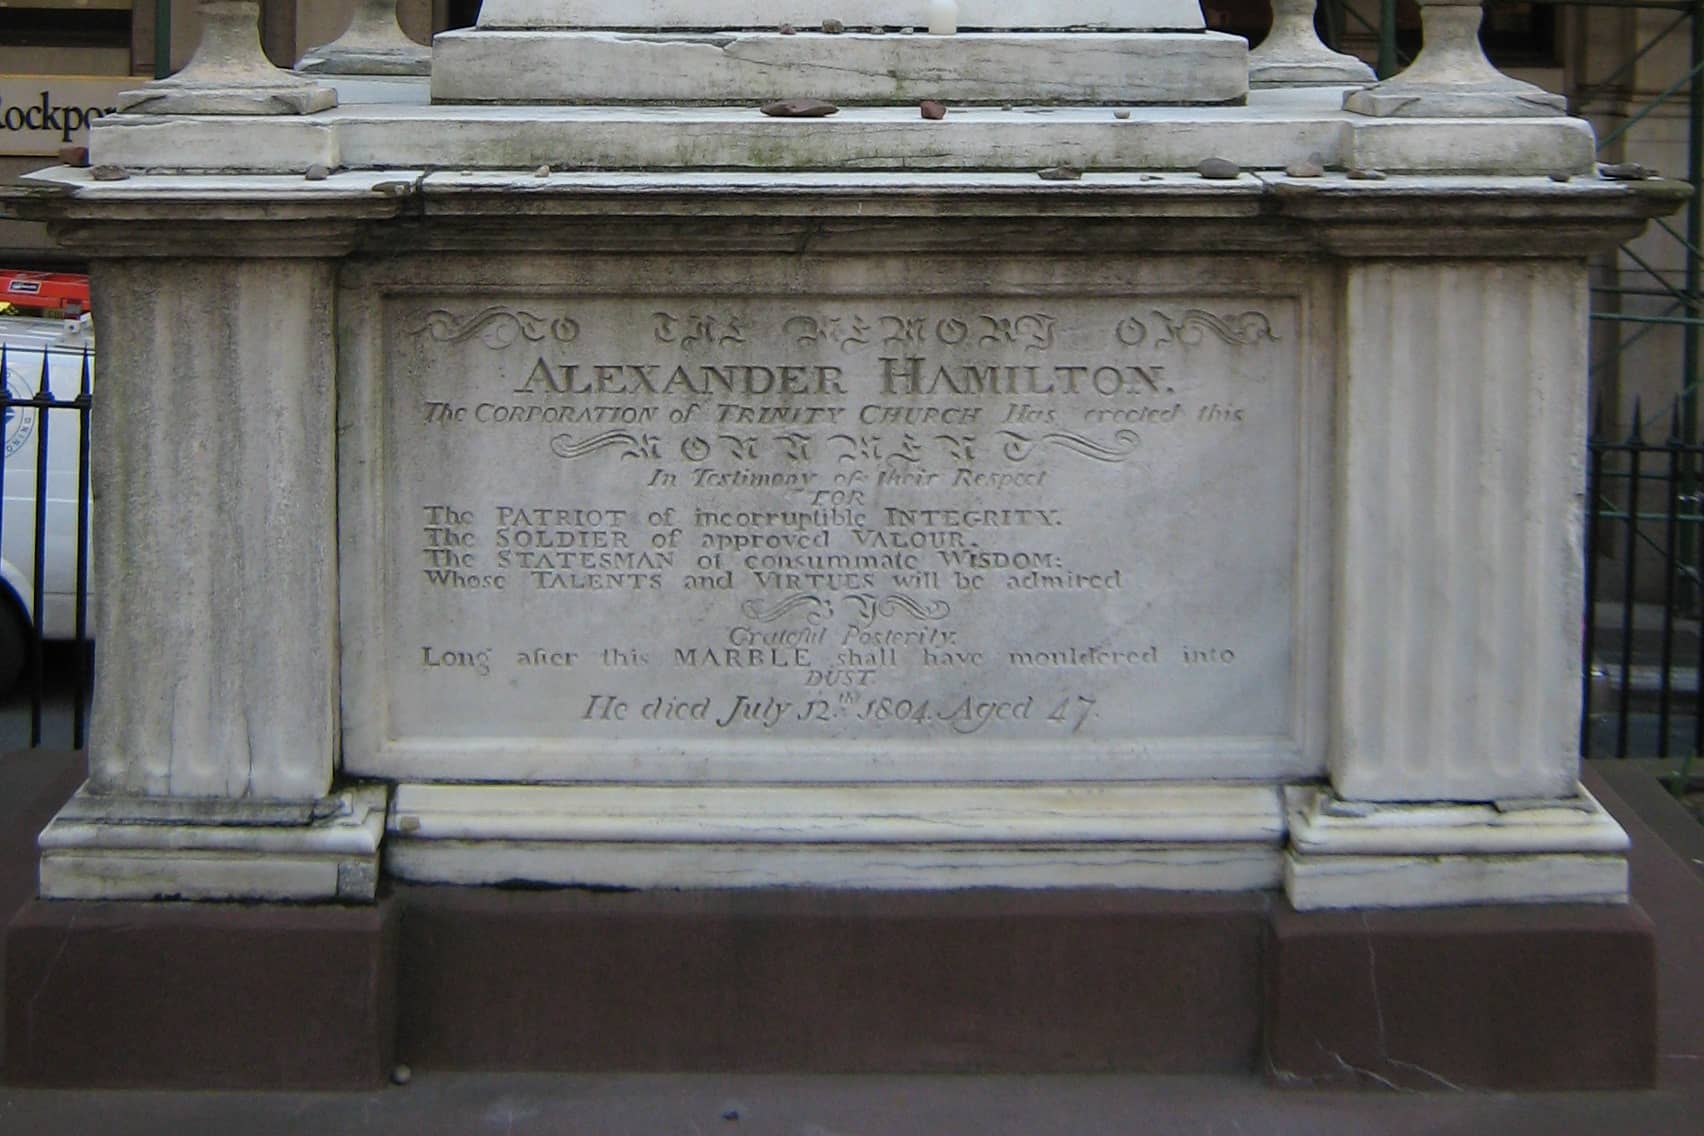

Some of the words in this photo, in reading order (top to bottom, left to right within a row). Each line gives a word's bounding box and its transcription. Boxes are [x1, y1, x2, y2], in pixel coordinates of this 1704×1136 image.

[514, 357, 848, 395] ALEXANDER
[877, 357, 1175, 396] HAMILTON.
[423, 401, 466, 424] The
[474, 401, 659, 424] CORPORATION
[670, 403, 699, 424] of
[717, 403, 846, 425] TRINITY
[859, 404, 984, 425] CHURCH
[1004, 403, 1057, 424] Has
[1083, 403, 1182, 423] erected
[1198, 402, 1245, 423] this
[647, 468, 678, 487] In
[691, 468, 820, 492] Testimony
[833, 469, 864, 487] of
[876, 468, 940, 487] their
[951, 468, 1048, 490] Respect
[811, 489, 866, 506] FOR
[423, 505, 475, 526] The
[496, 506, 628, 528] PATRIOT
[648, 507, 676, 526] of
[694, 507, 867, 532] incorruptible
[884, 507, 1063, 528] INTEGRITY.
[423, 527, 476, 548] The
[496, 529, 629, 549] SOLDIER
[651, 528, 683, 548] of
[701, 530, 830, 552] approved
[852, 529, 979, 549] VALOUR.
[423, 549, 475, 569] The
[497, 550, 675, 570] STATESMAN
[697, 553, 722, 570] of
[744, 551, 919, 570] consummate
[423, 569, 506, 590] Whose
[529, 571, 663, 591] TALENTS
[683, 570, 735, 590] and
[753, 570, 875, 591] VIRTUES
[892, 571, 938, 590] will
[954, 570, 986, 590] be
[1005, 569, 1123, 590] admired
[728, 625, 828, 647] Grateful
[422, 646, 492, 675] Long
[516, 647, 579, 666] after
[602, 646, 649, 666] this
[674, 647, 812, 667] MARBLE
[836, 647, 898, 666] shall
[922, 646, 984, 666] have
[1007, 645, 1159, 665] mouldered
[1182, 645, 1236, 664] into
[582, 695, 629, 721] He
[640, 696, 711, 721] died
[715, 694, 792, 728] July
[936, 694, 1036, 734] Aged
